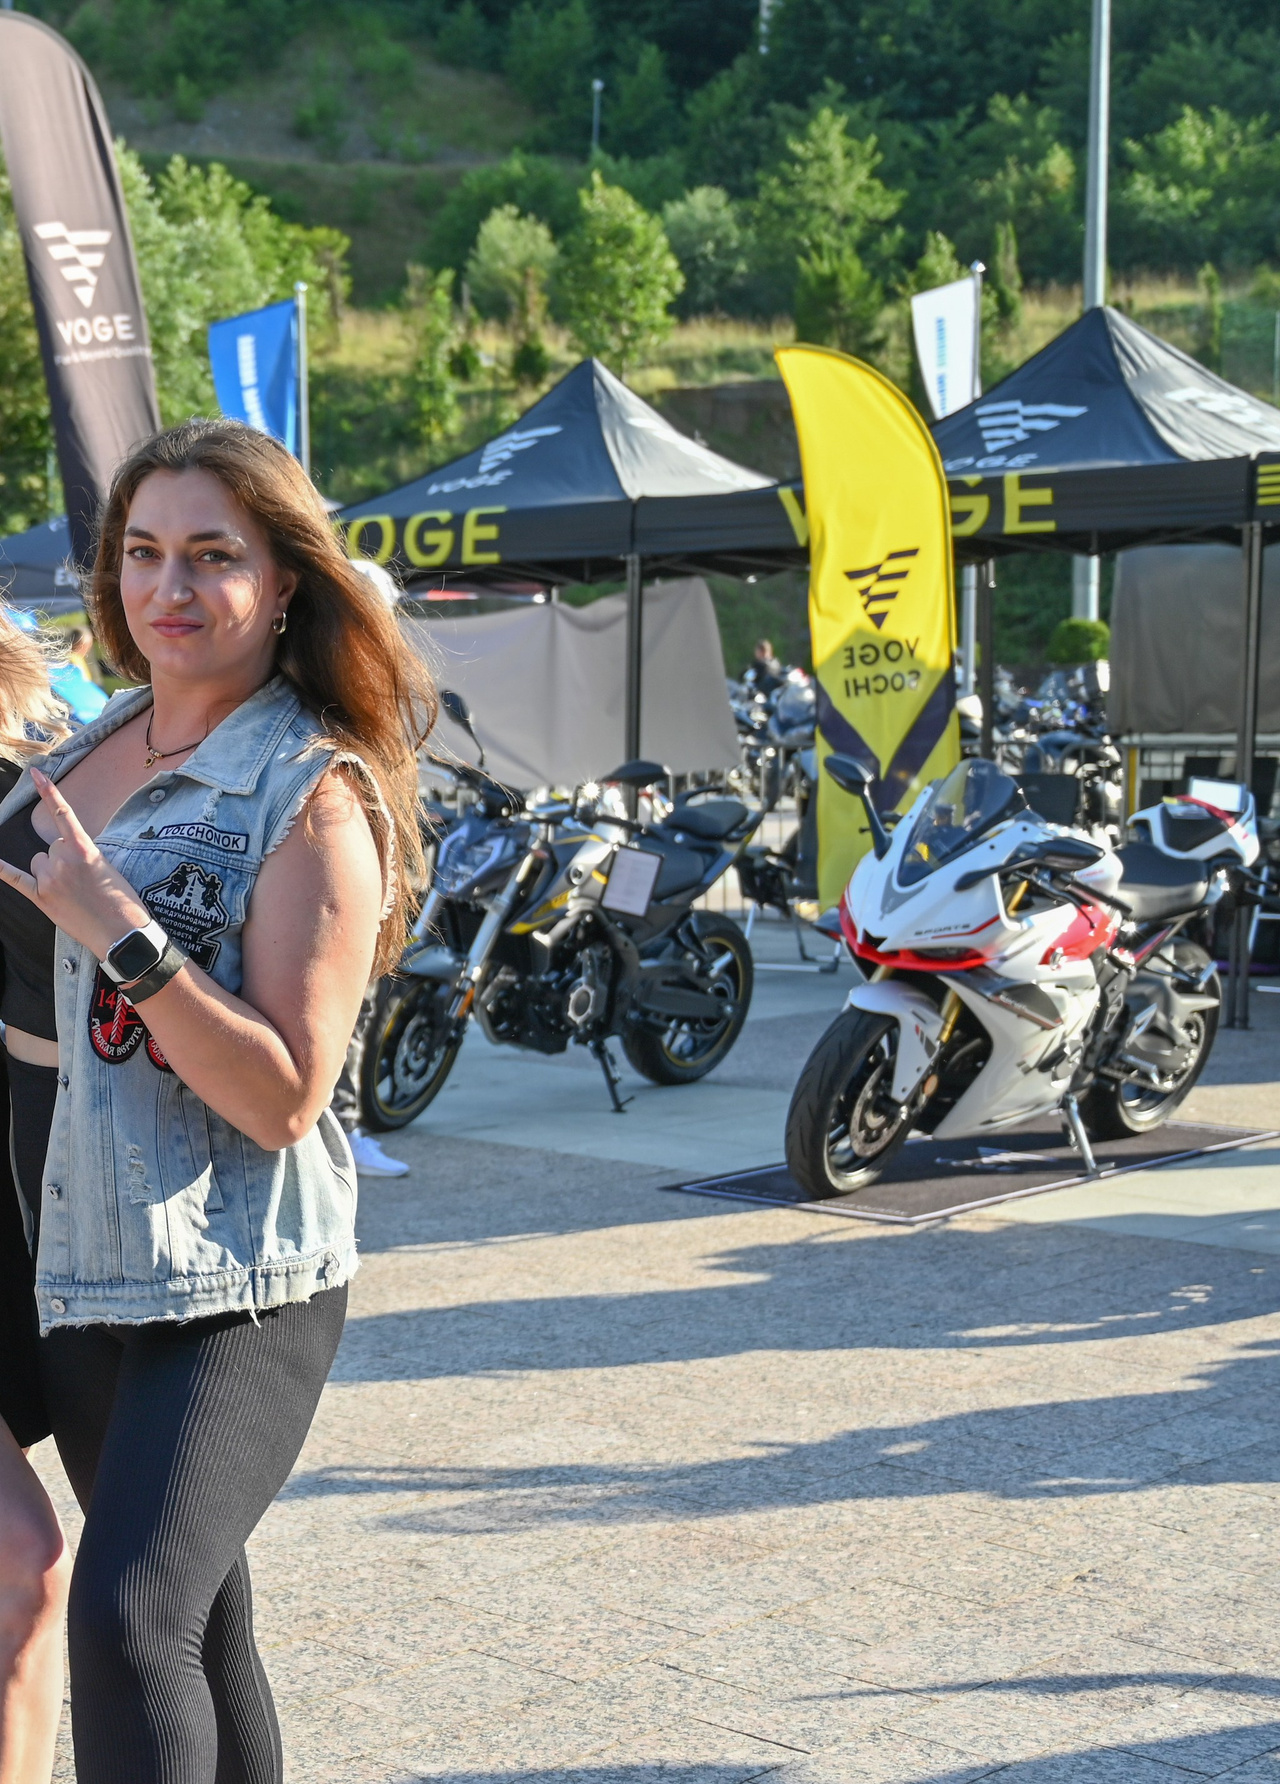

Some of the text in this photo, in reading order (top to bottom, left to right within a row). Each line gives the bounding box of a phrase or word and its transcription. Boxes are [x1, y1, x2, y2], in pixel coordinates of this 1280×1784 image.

[55, 314, 136, 346] VOGE
[944, 453, 1038, 471] OGE
[332, 505, 508, 567] OGE
[164, 825, 241, 849] VOLCHONOK
[146, 893, 224, 924] ВОЛНА ПАМЯТИ
[153, 905, 212, 929] МЕЖДУНАРОДНЫЙ
[160, 916, 200, 934] МОТОПРОБЕГ
